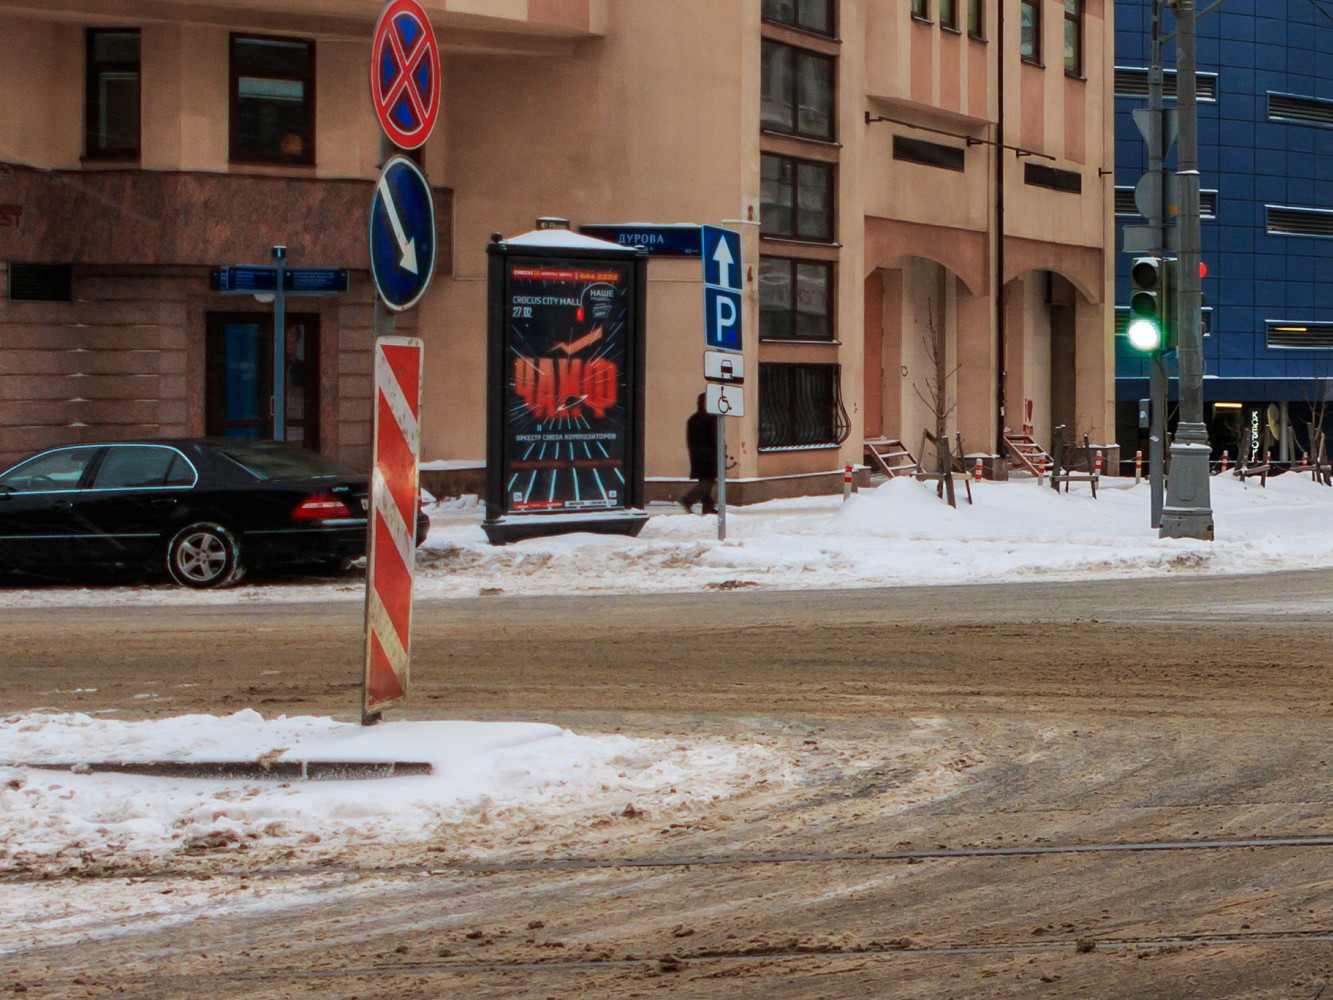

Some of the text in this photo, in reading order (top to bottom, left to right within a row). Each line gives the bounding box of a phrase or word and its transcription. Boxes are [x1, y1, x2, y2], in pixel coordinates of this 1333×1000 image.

[618, 234, 664, 244] ДУРОВА
[590, 290, 614, 298] НАШЕ
[512, 296, 580, 306] CROCUS CITY HALL
[514, 357, 618, 418] ЧАЙФ
